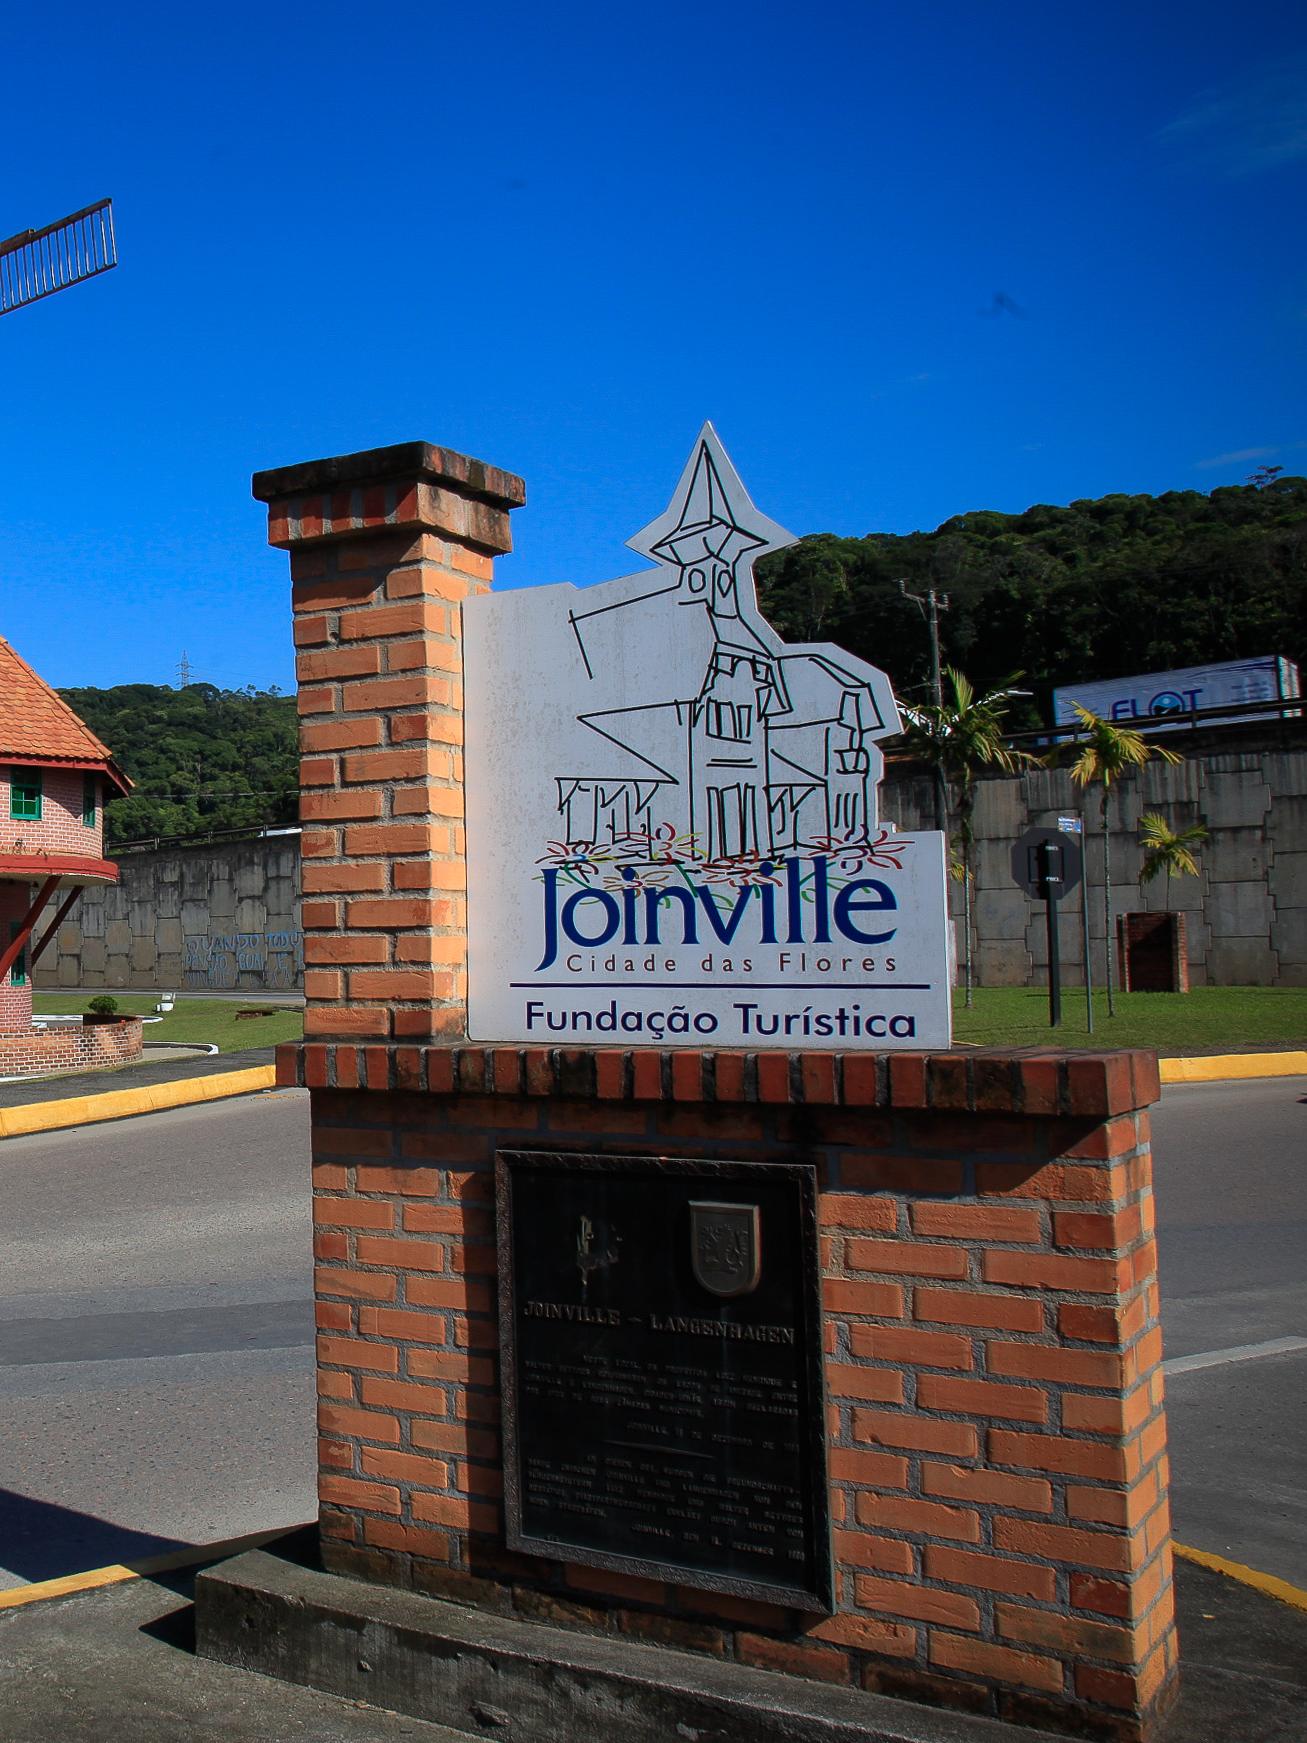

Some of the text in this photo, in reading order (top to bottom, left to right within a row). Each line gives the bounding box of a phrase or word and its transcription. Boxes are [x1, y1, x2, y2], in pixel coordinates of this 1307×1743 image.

[533, 856, 898, 972] Joinville
[566, 952, 897, 973] Cidade das Flores
[525, 1000, 916, 1040] Fundação Turística
[523, 1301, 621, 1326] JOINVILLE
[650, 1313, 794, 1345] LANGENHAGEN
